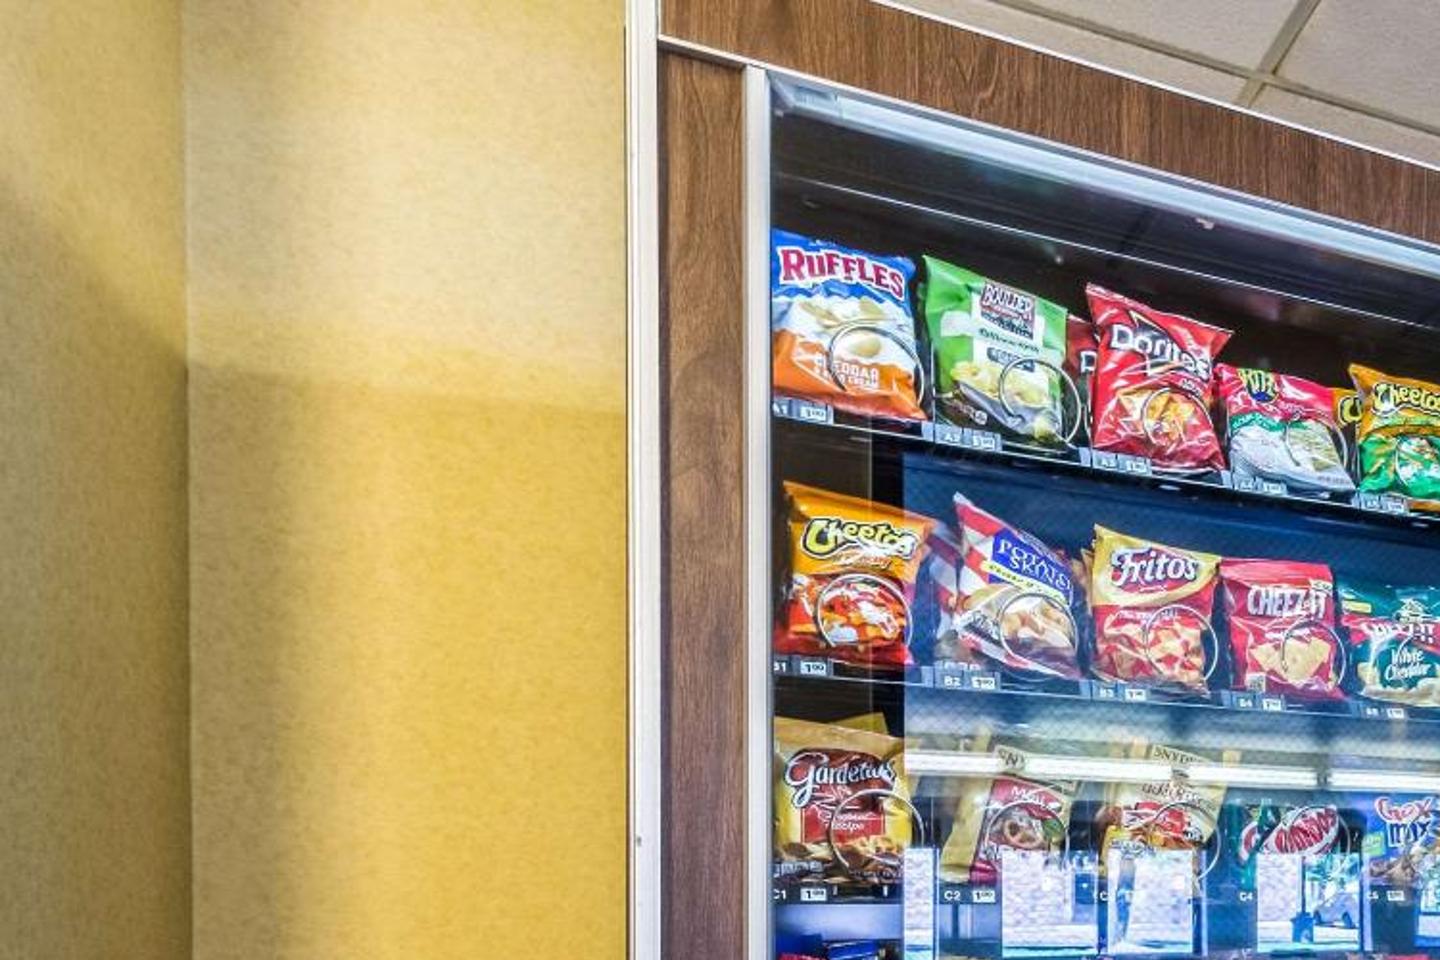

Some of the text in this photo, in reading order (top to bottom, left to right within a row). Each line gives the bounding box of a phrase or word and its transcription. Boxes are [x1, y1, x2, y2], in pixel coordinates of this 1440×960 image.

[779, 248, 905, 299] RUFFLES
[1110, 322, 1212, 382] Doritos
[802, 517, 919, 558] Cheetos
[1111, 546, 1200, 587] Fritos
